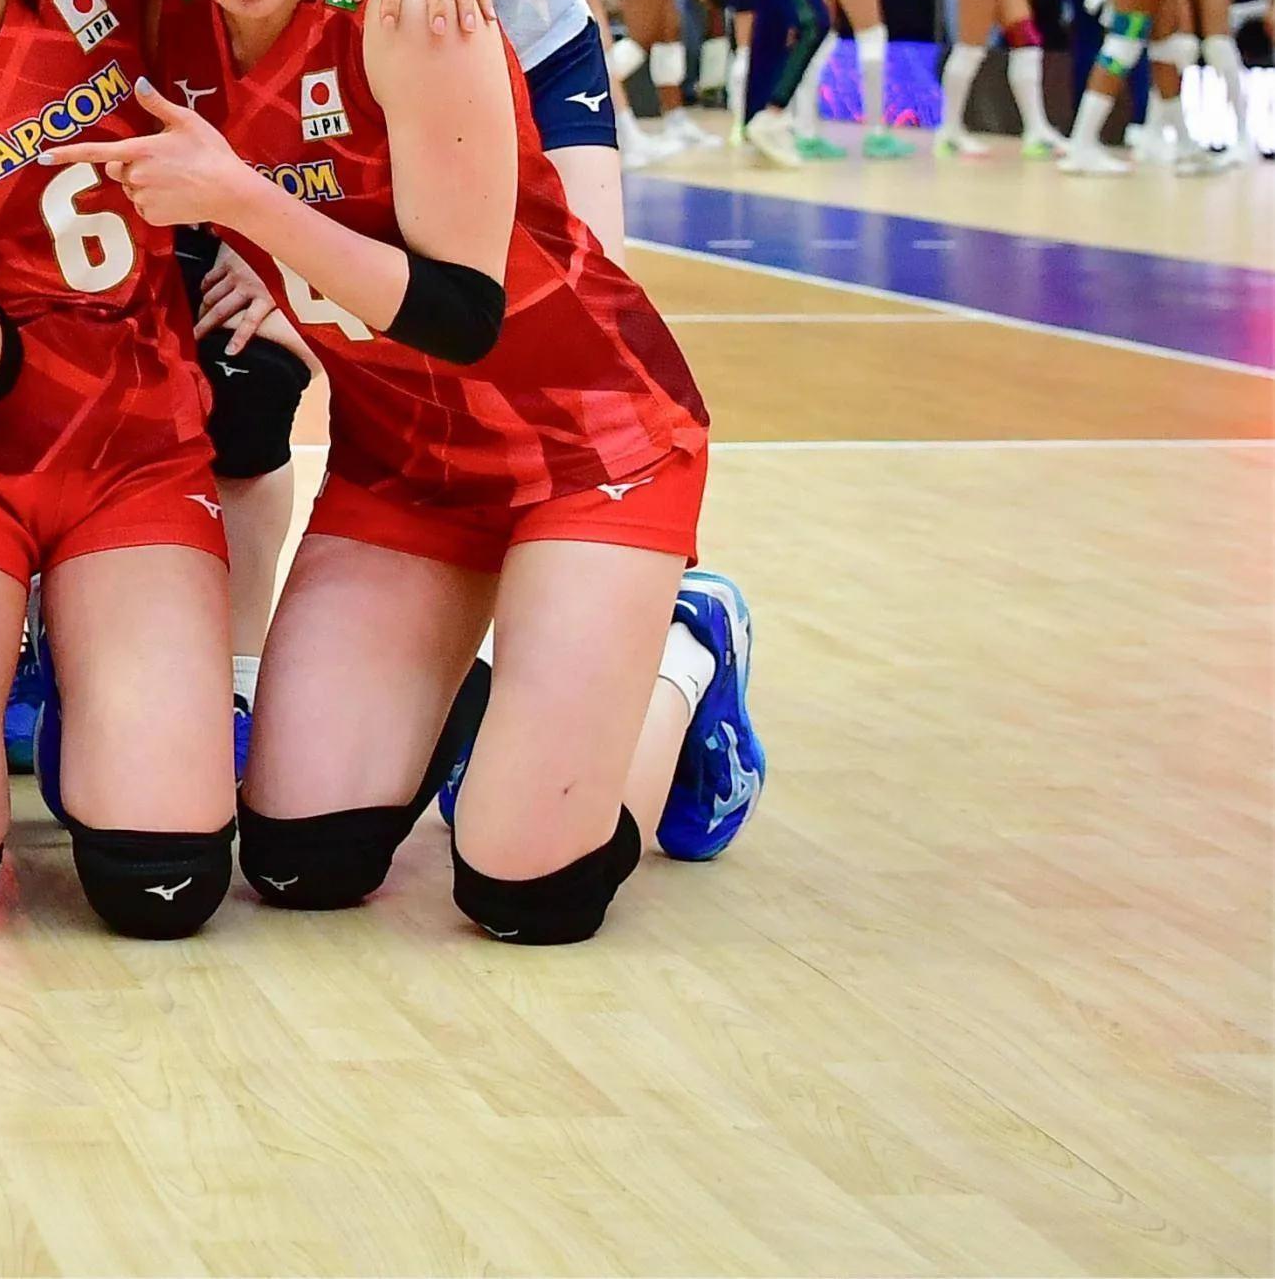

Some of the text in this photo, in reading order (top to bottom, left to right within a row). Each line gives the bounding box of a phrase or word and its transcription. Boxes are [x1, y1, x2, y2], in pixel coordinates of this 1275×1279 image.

[88, 13, 113, 45] JPN
[310, 119, 342, 136] JPN
[40, 162, 137, 293] 6
